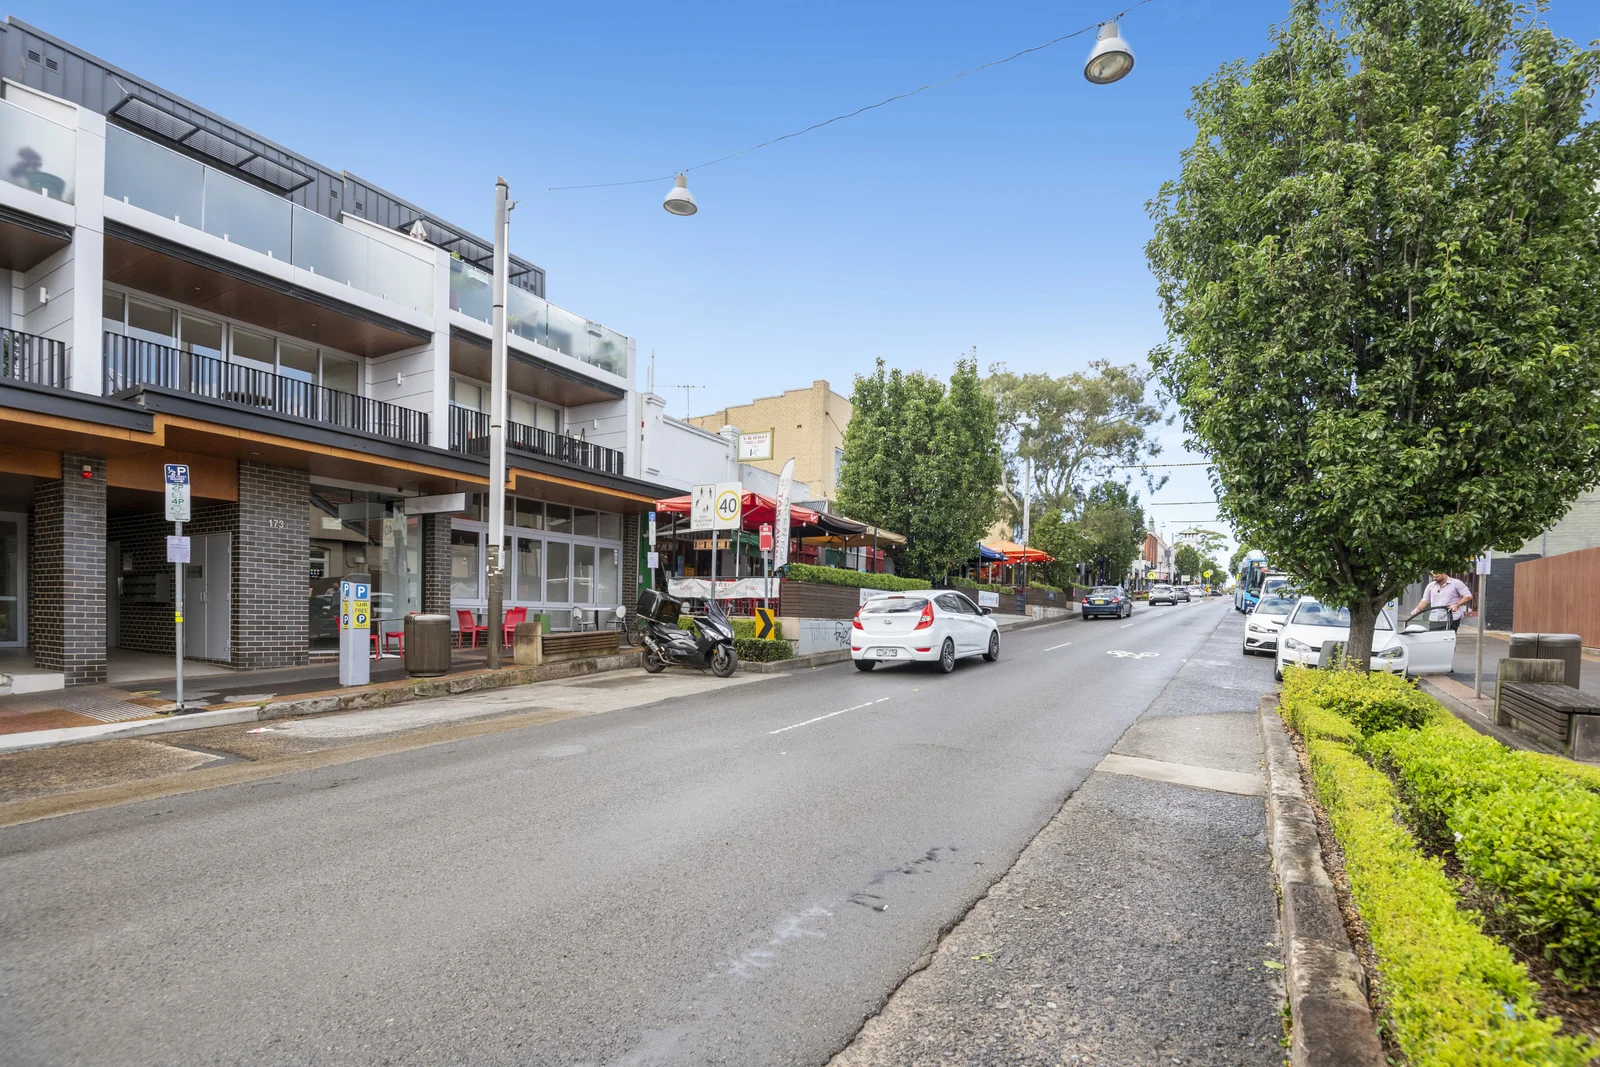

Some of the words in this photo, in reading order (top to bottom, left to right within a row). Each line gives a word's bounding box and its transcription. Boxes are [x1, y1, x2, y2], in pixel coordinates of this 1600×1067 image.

[171, 483, 184, 491] 2P
[718, 498, 737, 514] 40
[269, 519, 285, 529] 173
[358, 586, 366, 598] P
[358, 614, 365, 623] P
